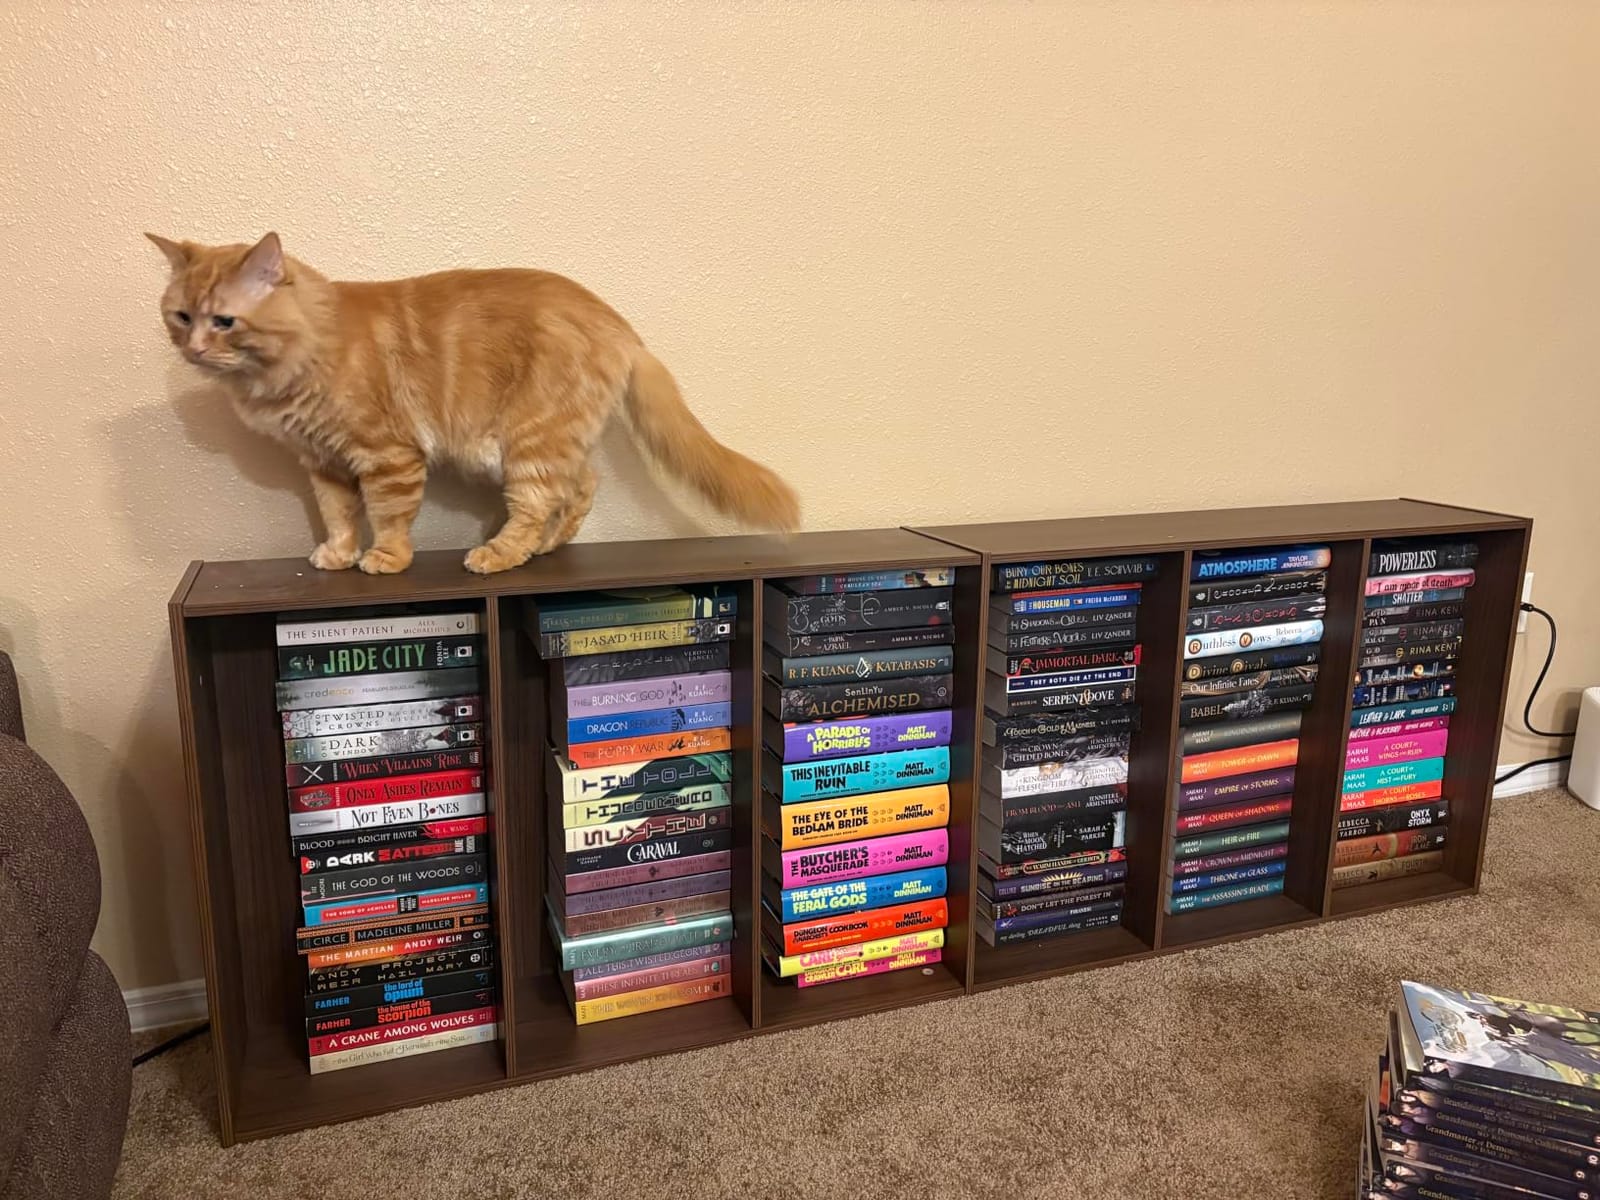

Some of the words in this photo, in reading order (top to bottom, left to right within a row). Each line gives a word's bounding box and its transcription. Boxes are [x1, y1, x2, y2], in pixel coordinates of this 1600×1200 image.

[1198, 557, 1278, 577] ATMOSPHERE
[1378, 550, 1437, 573] POWERLESS
[1005, 567, 1028, 579] BURY
[1031, 565, 1052, 576] OUR
[1058, 573, 1083, 585] SOIL
[1384, 582, 1398, 592] am
[1431, 577, 1454, 588] death
[1032, 598, 1071, 610] HOUSEMAID
[1392, 591, 1424, 605] SHATTER
[286, 630, 306, 640] THE
[311, 627, 346, 638] SILENT
[352, 626, 393, 636] PATIENT
[583, 631, 627, 648] JASAD
[629, 628, 668, 643] HEIR
[1104, 629, 1131, 640] ZANDER
[1188, 638, 1236, 654] Ruthless
[1239, 631, 1272, 648] Vows
[1409, 644, 1432, 656] RINA
[1434, 641, 1458, 653] KENT
[323, 648, 377, 674] JADE
[382, 643, 425, 669] CITY
[788, 669, 797, 679] R.
[801, 668, 809, 678] F.
[811, 664, 855, 677] KUANG
[875, 658, 936, 672] KATABASIS
[1186, 663, 1229, 680] Divine
[1230, 658, 1268, 674] Rivals
[1030, 678, 1046, 686] THEY
[1094, 672, 1107, 680] THE
[1189, 682, 1208, 693] Our
[1209, 677, 1238, 692] Infinite
[1238, 676, 1260, 688] Fates
[592, 692, 637, 707] BURNING
[639, 689, 664, 701] GOD
[687, 688, 714, 697] KUANG
[845, 686, 884, 697] SenLinYu
[1089, 689, 1115, 701] DOVE
[807, 692, 921, 716] ALCHEMISED
[321, 710, 385, 723] TWISTED
[1190, 705, 1224, 718] BABEL
[328, 720, 379, 731] CROWNS
[687, 714, 714, 724] KUANG
[587, 721, 628, 734] DRAGON
[806, 731, 815, 742] A
[814, 726, 862, 741] PARADE
[906, 724, 927, 734] MATT
[329, 735, 379, 750] DARK
[1390, 741, 1413, 751] COURT
[434, 753, 462, 769] RISE
[905, 761, 925, 771] MATT
[1350, 755, 1369, 764] MAAS
[790, 767, 813, 781] THIS
[813, 760, 871, 778] INEVITABLE
[896, 767, 934, 778] DINNIMAN
[1379, 768, 1386, 776] A
[1386, 766, 1409, 775] COURT
[815, 776, 847, 792] RUIN
[1346, 781, 1366, 790] MAAS
[1376, 775, 1392, 784] MIST
[1400, 773, 1417, 782] FURY
[346, 785, 376, 804] ONLY
[381, 780, 417, 801] ASHES
[419, 773, 463, 795] REMAIN
[1214, 781, 1239, 796] EMPIRE
[1250, 778, 1280, 791] STORMS
[904, 804, 924, 813] MATT
[1346, 800, 1366, 808] MAAS
[351, 809, 377, 829] NOT
[382, 805, 414, 825] EVEN
[791, 815, 811, 825] THE
[814, 811, 832, 822] EYE
[835, 809, 848, 819] OF
[850, 806, 869, 816] THE
[895, 809, 934, 822] DINNIMAN
[1209, 812, 1234, 823] QUEEN
[1410, 808, 1431, 819] ONYX
[791, 823, 835, 836] BEDLAM
[838, 815, 869, 828] BRIDE
[1407, 817, 1432, 827] STORM
[1080, 831, 1106, 840] PARKER
[1221, 834, 1238, 846] HEIR
[1246, 832, 1260, 841] FIRE
[300, 838, 334, 852] BLOOD
[626, 840, 681, 864] CARAVAL
[903, 845, 924, 855] MATT
[326, 850, 376, 868] DARK
[799, 846, 870, 867] BUTCHER'S
[895, 850, 933, 863] DINNIMAN
[791, 859, 799, 876] THE
[800, 859, 870, 878] MASQUERADE
[332, 881, 346, 891] THE
[350, 877, 378, 889] GOD
[380, 875, 396, 885] OF
[398, 872, 412, 882] THE
[415, 867, 460, 880] WOODS
[1209, 872, 1238, 884] THRONE
[1247, 866, 1269, 877] GLASS
[790, 891, 809, 901] THE
[810, 888, 834, 899] GATE
[836, 885, 849, 896] OF
[849, 881, 867, 892] THE
[893, 885, 932, 898] DINNIMAN
[902, 879, 922, 890] MATT
[793, 899, 828, 915] FERAL
[829, 892, 867, 908] GODS
[1021, 902, 1043, 912] DON'T
[1045, 900, 1059, 909] LET
[1060, 898, 1074, 906] THE
[1075, 893, 1099, 904] FOREST
[1100, 891, 1112, 899] IN
[895, 915, 933, 929] DINNIMAN
[903, 910, 922, 920] MATT
[313, 933, 346, 946] CIRCE
[357, 924, 414, 940] MADELINE
[416, 919, 452, 934] MILLER
[793, 925, 828, 937] DUNGEON
[829, 921, 869, 934] COOKBOOK
[319, 953, 340, 963] THE
[345, 944, 394, 960] MARTIAN
[404, 938, 432, 950] ANDY
[436, 934, 463, 944] WEIR
[381, 953, 458, 971] PROJECT
[836, 961, 868, 977] CARL
[888, 955, 927, 970] DINNIMAN
[317, 968, 360, 981] ANDY
[377, 969, 417, 981] HAIL
[425, 962, 463, 973] MARY
[317, 978, 361, 990] WEIR
[383, 986, 424, 1002] opium
[315, 996, 350, 1009] FARMER
[377, 1006, 431, 1024] scorpion
[316, 1018, 351, 1031] FARMER
[328, 1038, 338, 1049] A
[341, 1032, 380, 1046] CRANE
[383, 1023, 427, 1039] AMONG
[430, 1014, 474, 1029] WOLVES
[1425, 1123, 1478, 1144] Grandmaster
[1575, 1170, 1586, 1180] 9
